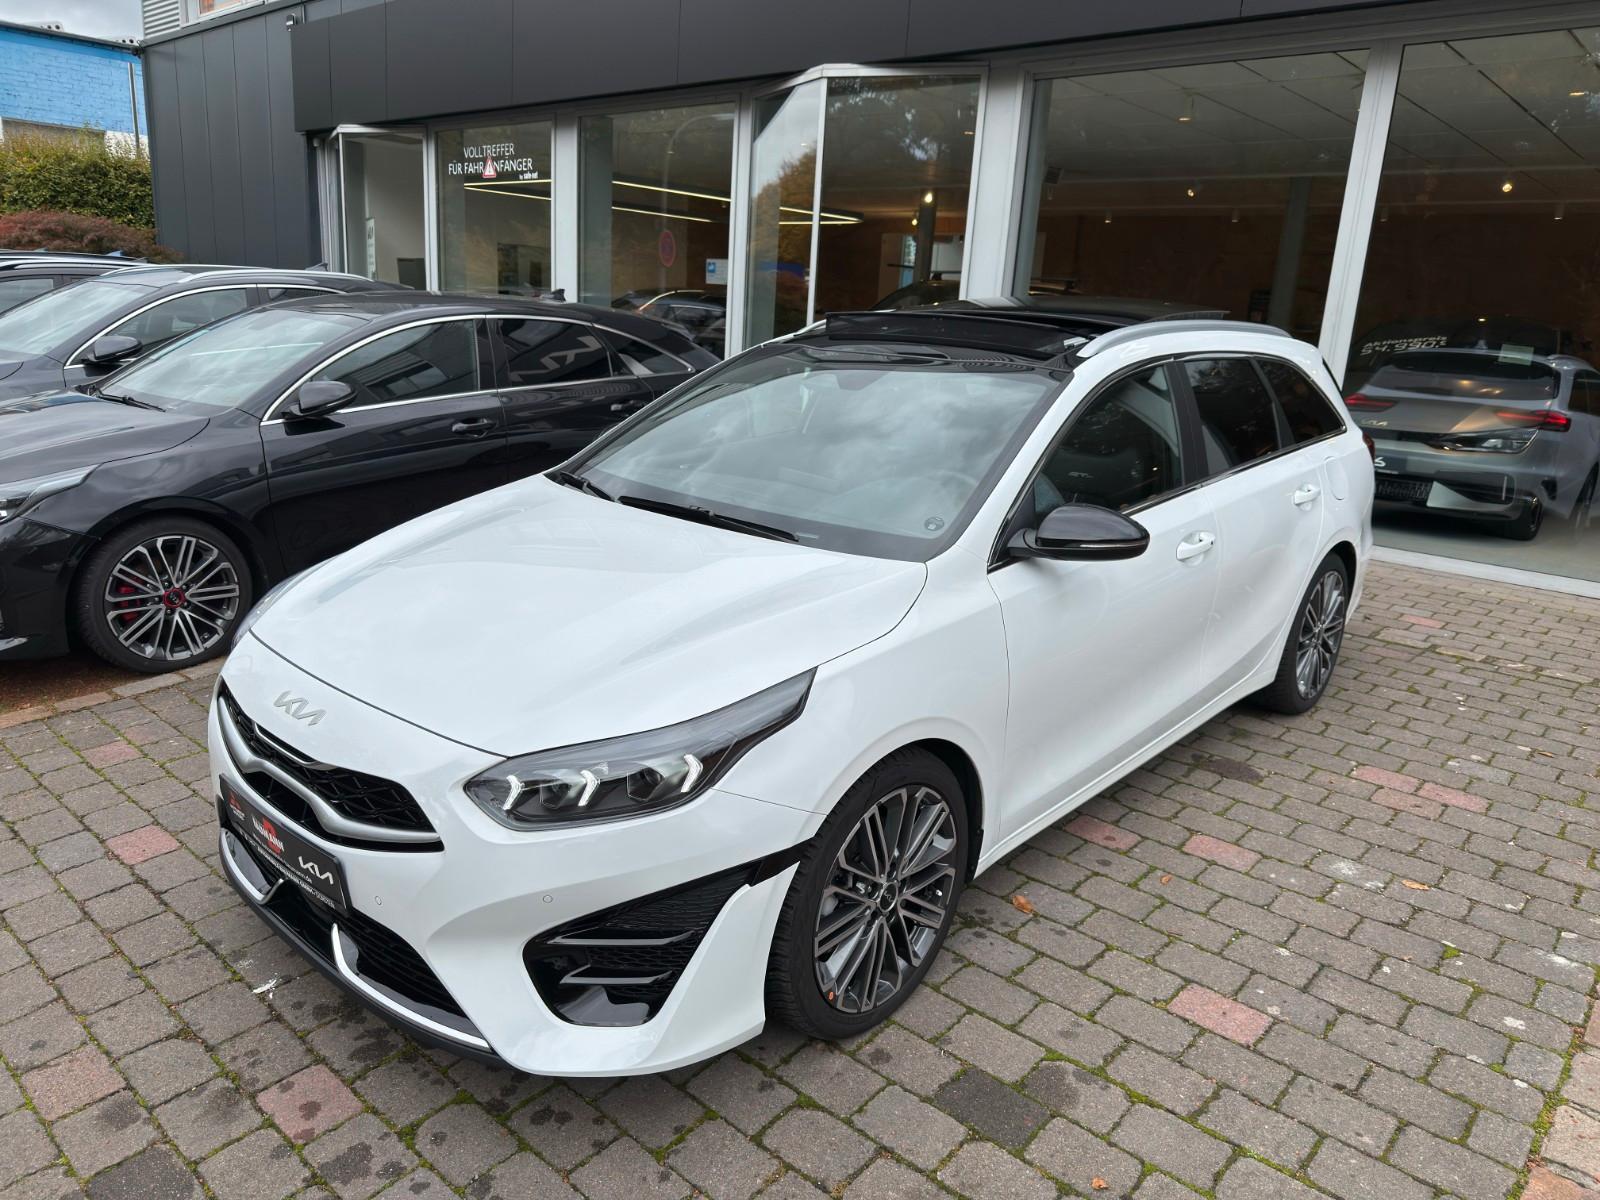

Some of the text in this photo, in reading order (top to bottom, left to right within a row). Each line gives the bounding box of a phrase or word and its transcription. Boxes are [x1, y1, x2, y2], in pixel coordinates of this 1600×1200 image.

[464, 143, 514, 158] VOLLTREFFER
[448, 160, 462, 175] FÜR
[273, 690, 327, 726] KIA
[298, 856, 334, 884] KIA
